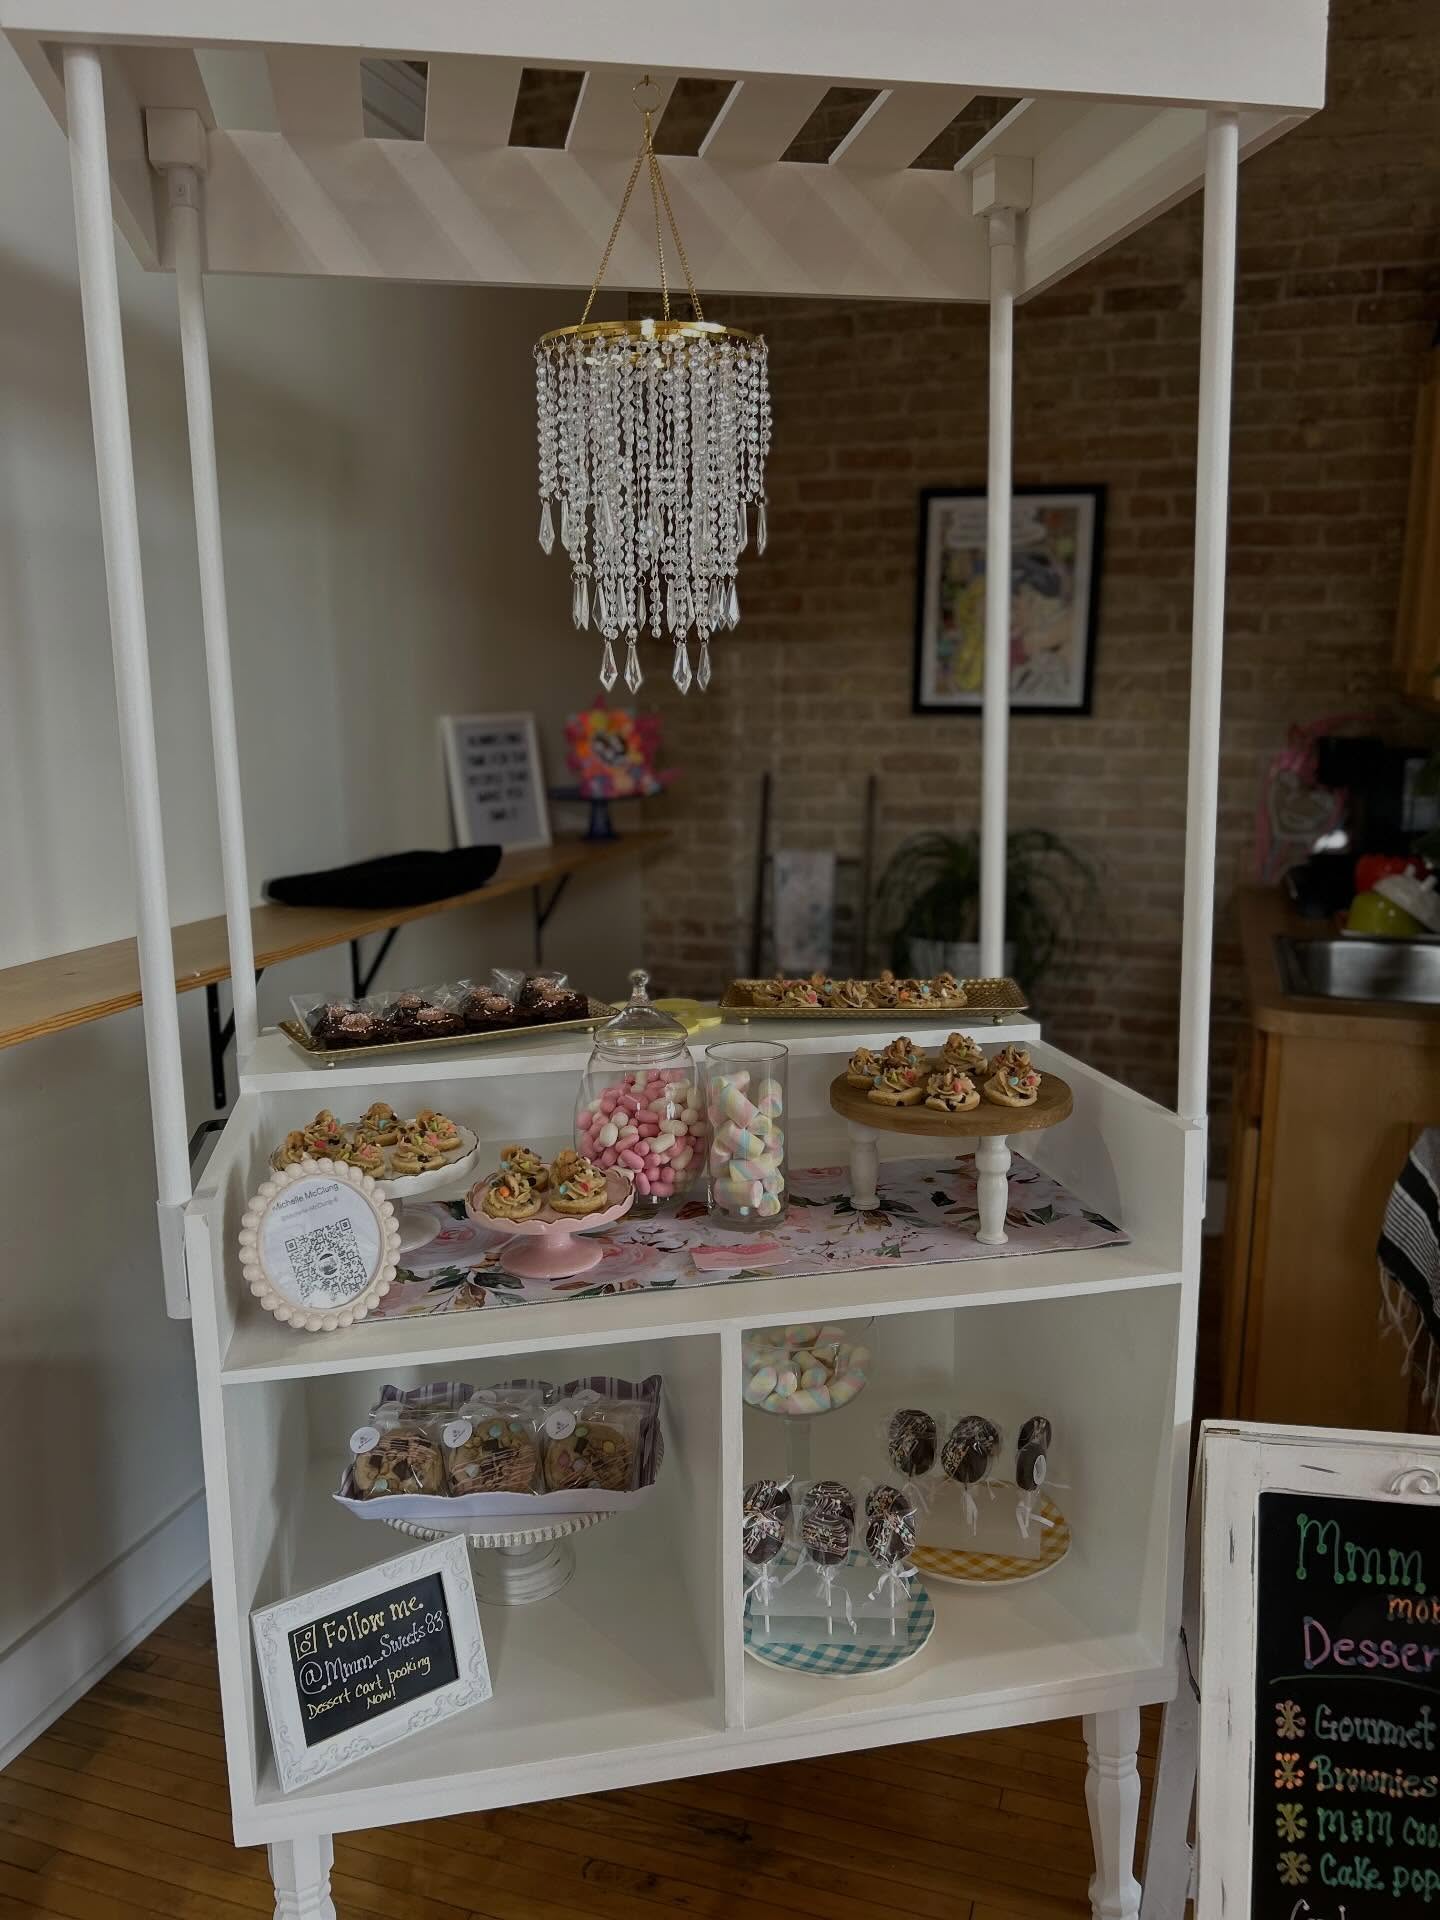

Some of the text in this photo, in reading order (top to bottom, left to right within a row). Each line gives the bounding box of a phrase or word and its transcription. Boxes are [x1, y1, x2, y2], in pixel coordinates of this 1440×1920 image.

[303, 1183, 339, 1199] McClung
[1296, 1512, 1427, 1595] Mmm
[322, 1596, 424, 1649] Follow me
[306, 1687, 352, 1720] Dessert
[386, 1656, 431, 1684] booking
[1314, 1703, 1436, 1751] Gourmet
[1308, 1754, 1440, 1798] Brownies
